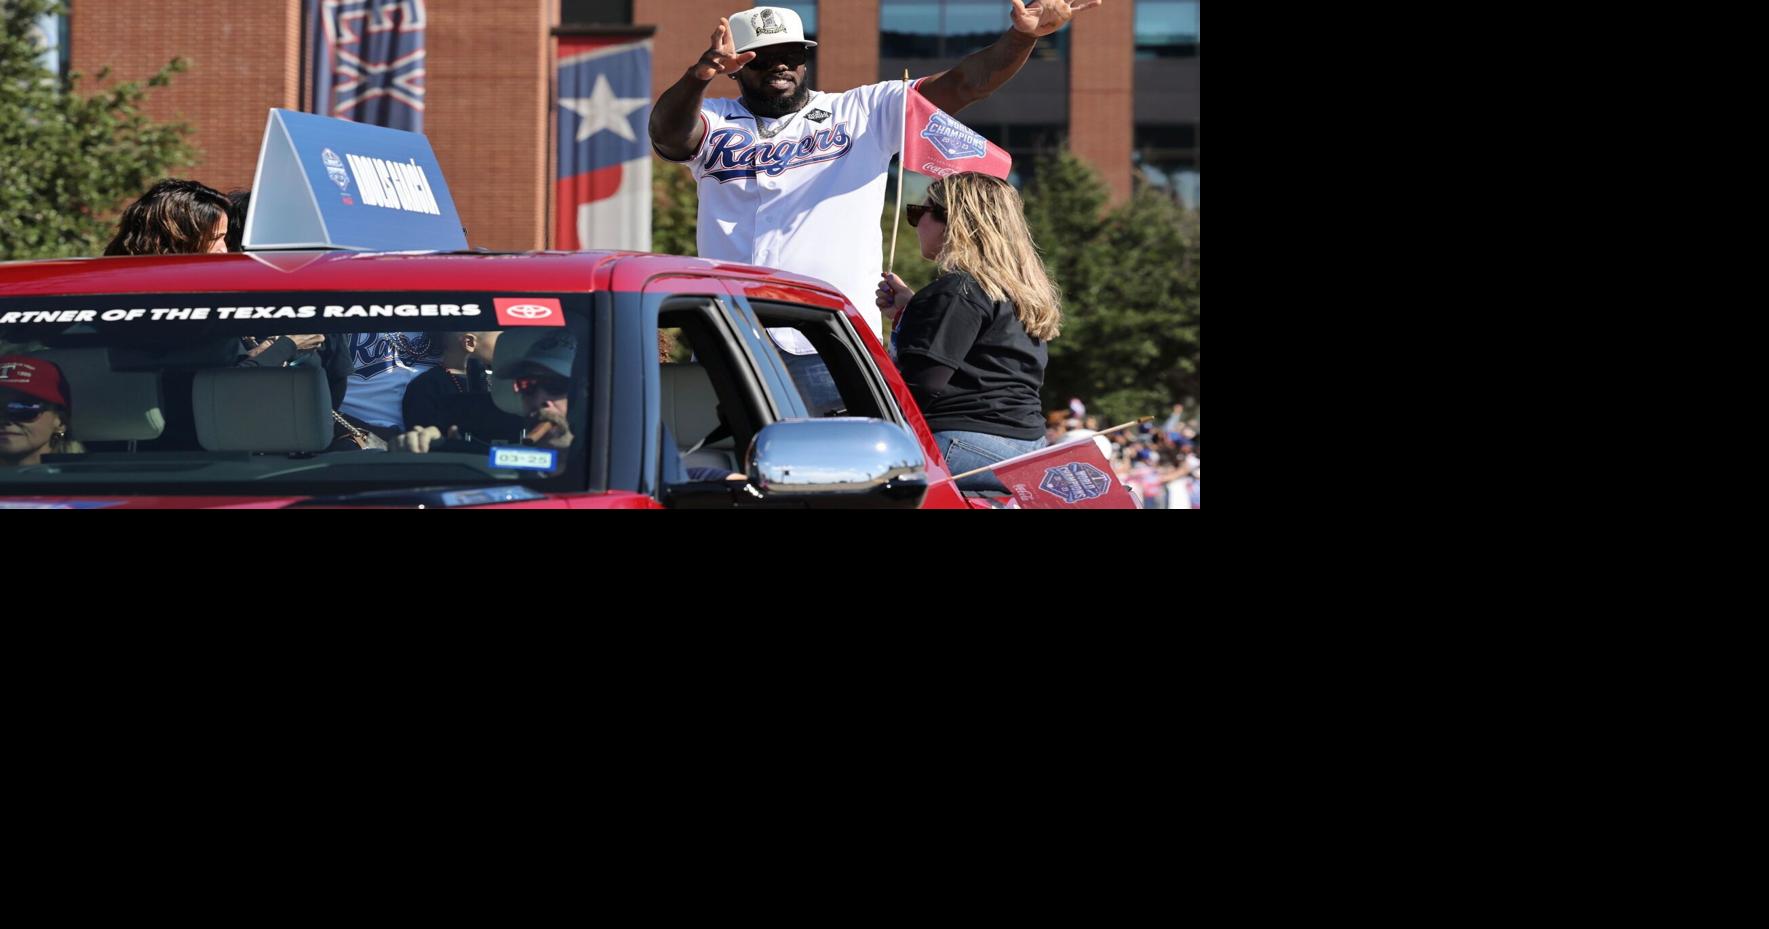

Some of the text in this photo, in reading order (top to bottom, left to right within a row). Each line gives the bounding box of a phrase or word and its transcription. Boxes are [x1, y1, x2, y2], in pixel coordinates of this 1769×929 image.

[928, 122, 985, 149] CHAMPIONS
[701, 121, 853, 184] Rangers
[101, 309, 146, 321] OF
[151, 307, 211, 320] THE
[217, 306, 316, 319] TEXAS
[323, 304, 481, 318] RANGERS
[499, 454, 548, 464] 03-25
